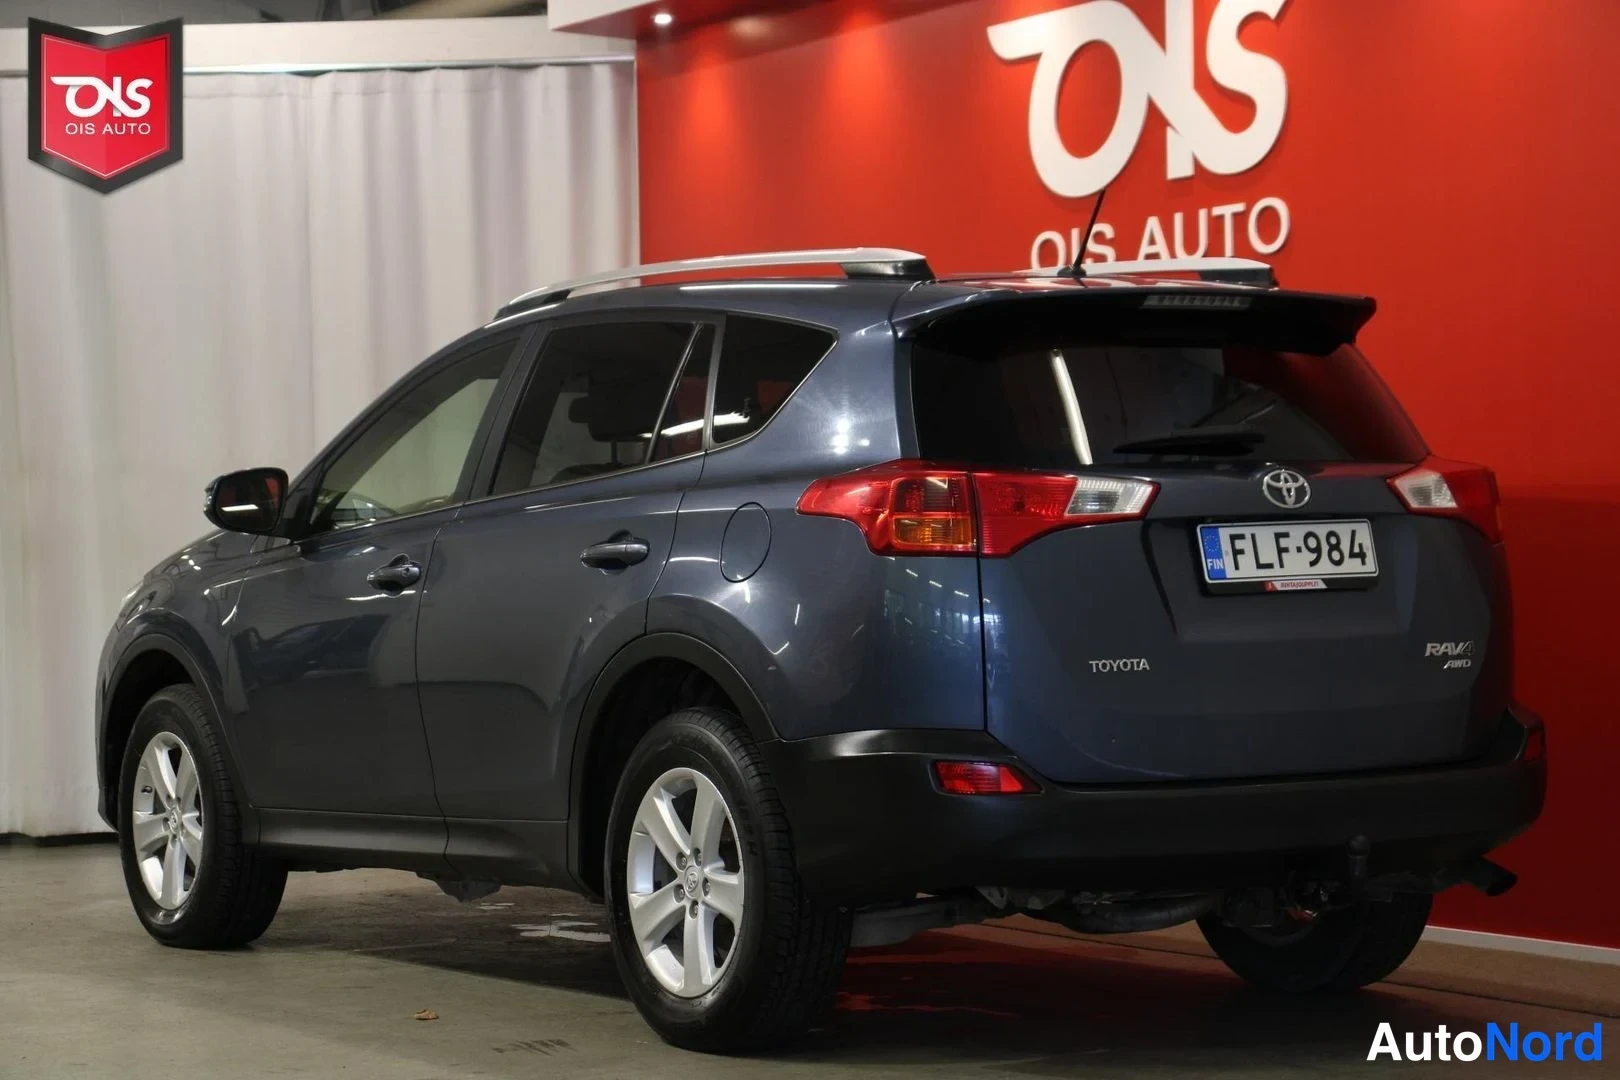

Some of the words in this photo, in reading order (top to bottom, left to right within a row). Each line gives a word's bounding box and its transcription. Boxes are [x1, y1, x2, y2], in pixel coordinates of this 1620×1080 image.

[986, 0, 1288, 198] OIS
[1030, 222, 1118, 271] OIS
[1137, 196, 1291, 261] AUTO
[1229, 529, 1368, 571] FLF-984
[1206, 558, 1224, 570] FIN
[1424, 640, 1473, 657] RAV4
[1089, 658, 1151, 673] TOYOTA
[1443, 659, 1472, 670] AWD
